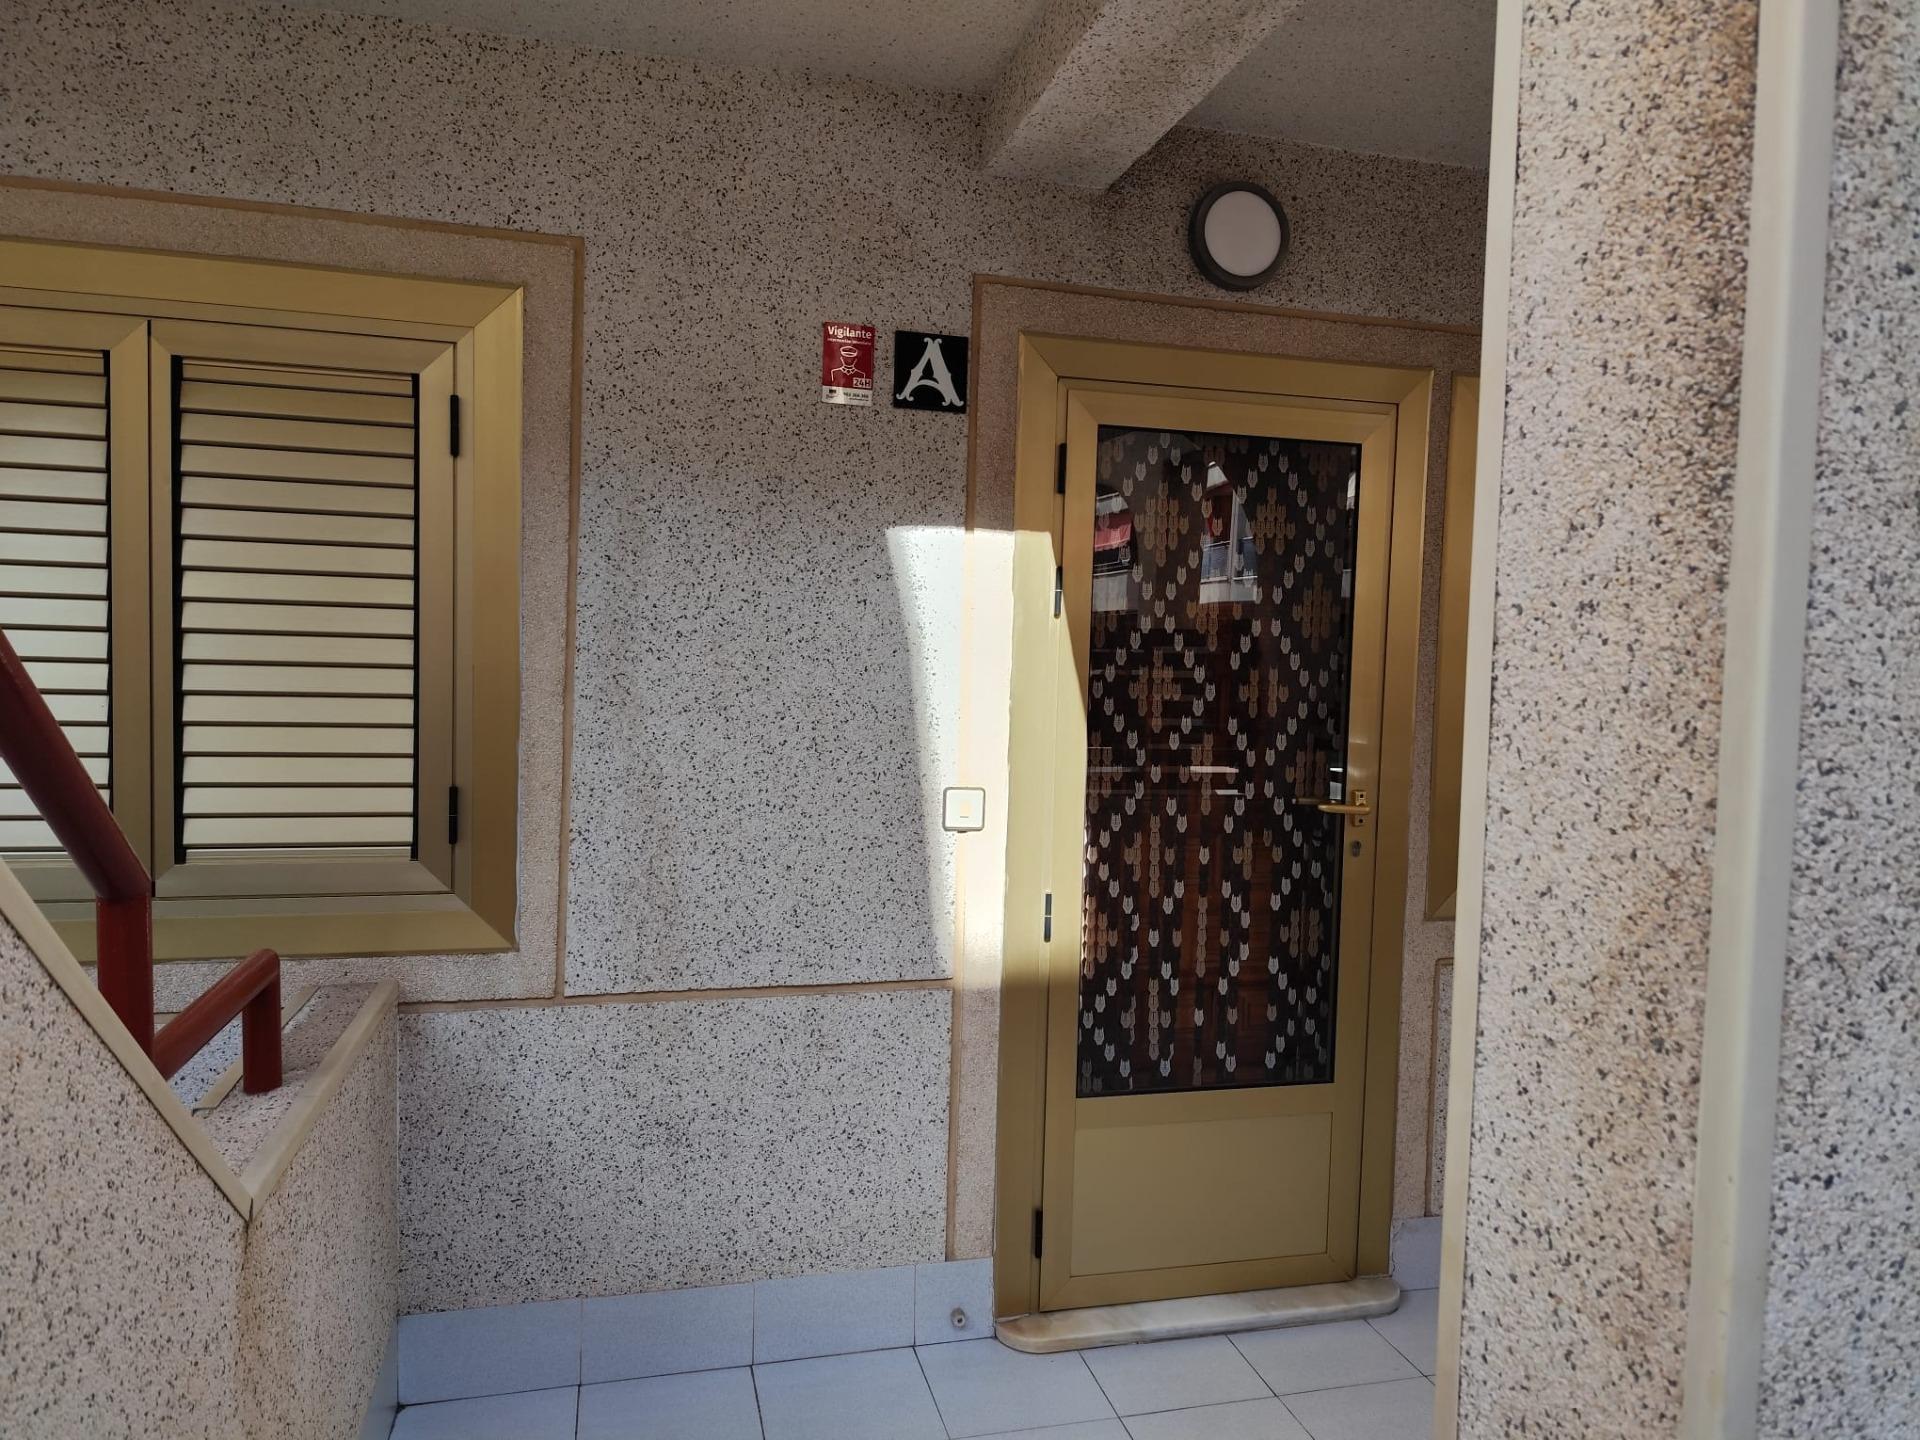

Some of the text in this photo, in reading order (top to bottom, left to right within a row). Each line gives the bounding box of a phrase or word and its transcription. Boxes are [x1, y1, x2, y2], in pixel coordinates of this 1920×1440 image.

[827, 325, 873, 339] Vigilante
[896, 337, 965, 407] A
[854, 378, 871, 387] 24H
